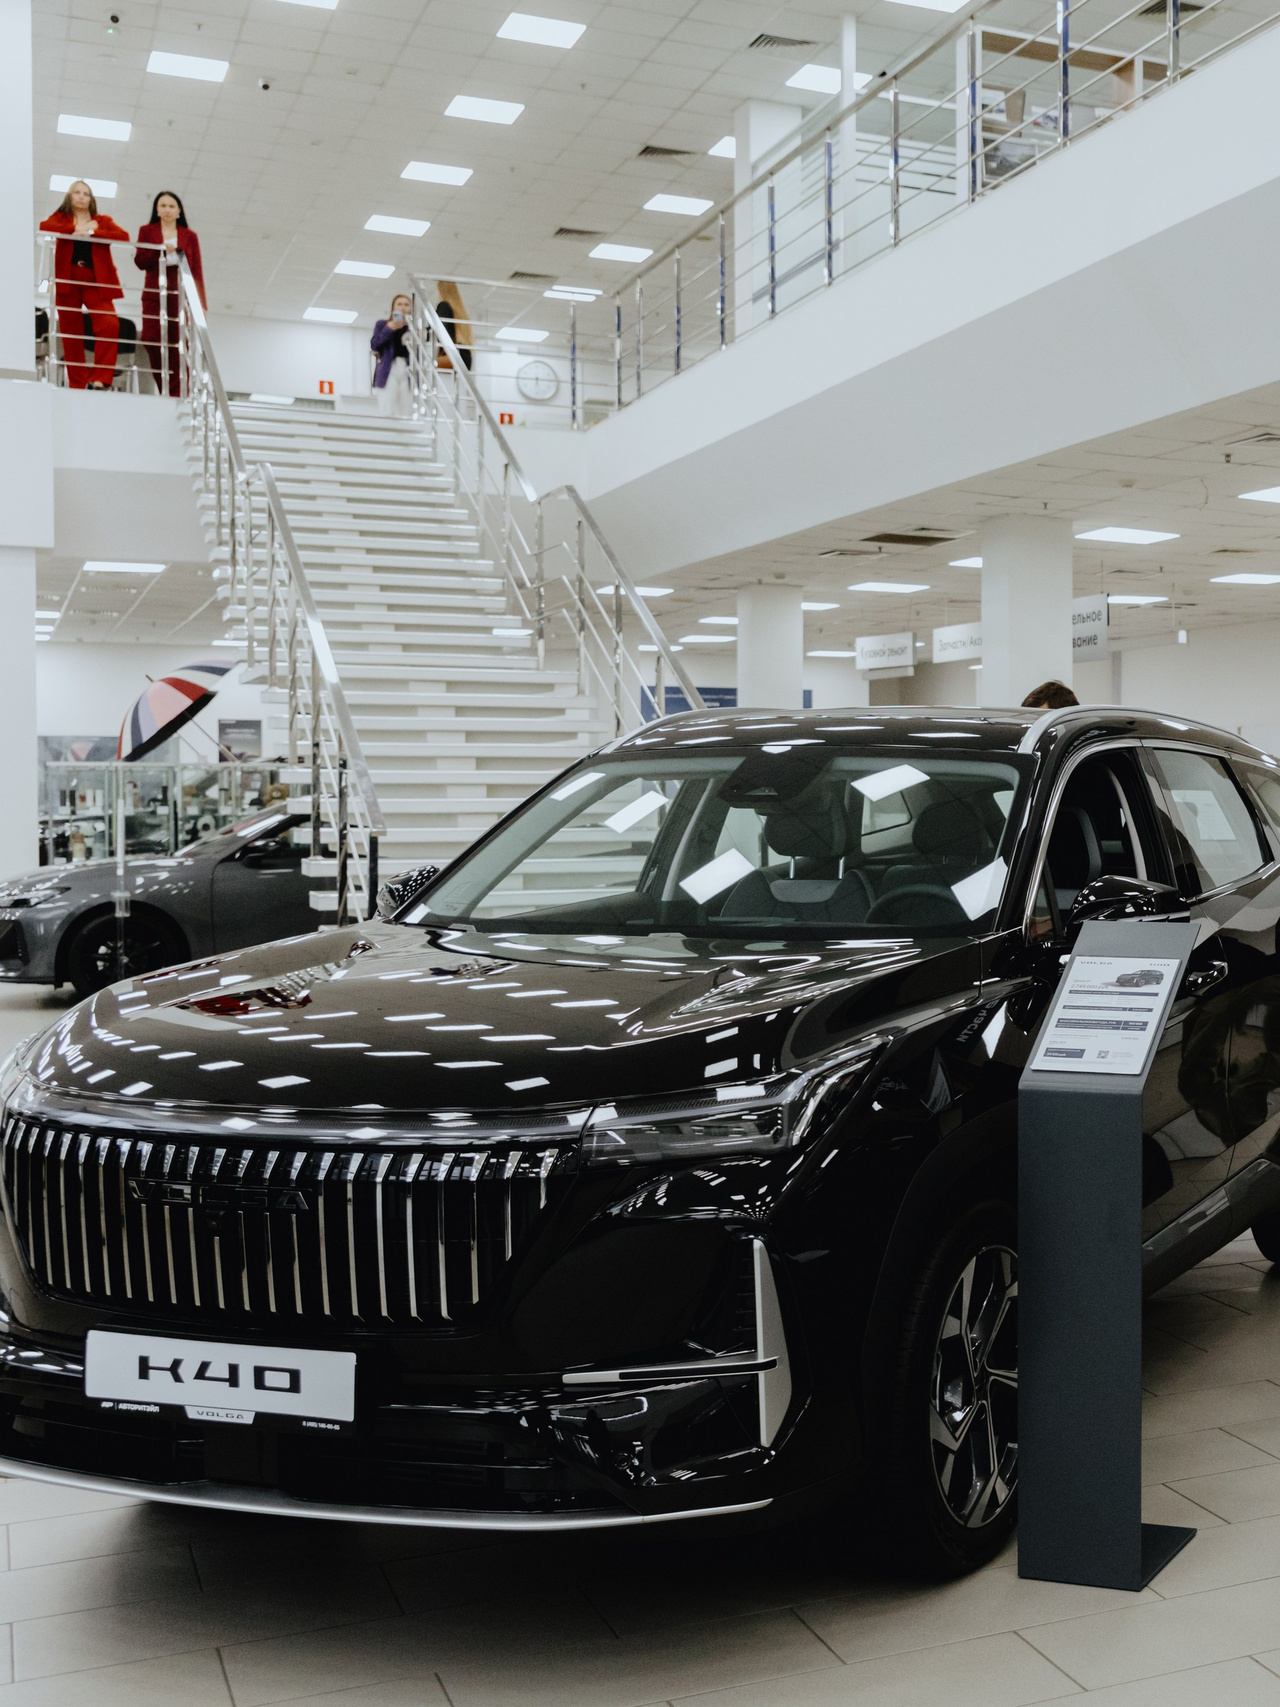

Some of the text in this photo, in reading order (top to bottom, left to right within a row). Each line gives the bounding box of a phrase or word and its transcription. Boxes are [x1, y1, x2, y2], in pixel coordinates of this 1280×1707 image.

[1072, 610, 1102, 625] ельное
[1072, 634, 1098, 648] вание
[127, 1180, 309, 1210] VOLGA
[138, 1355, 301, 1394] K40
[196, 1410, 244, 1420] VOLGA
